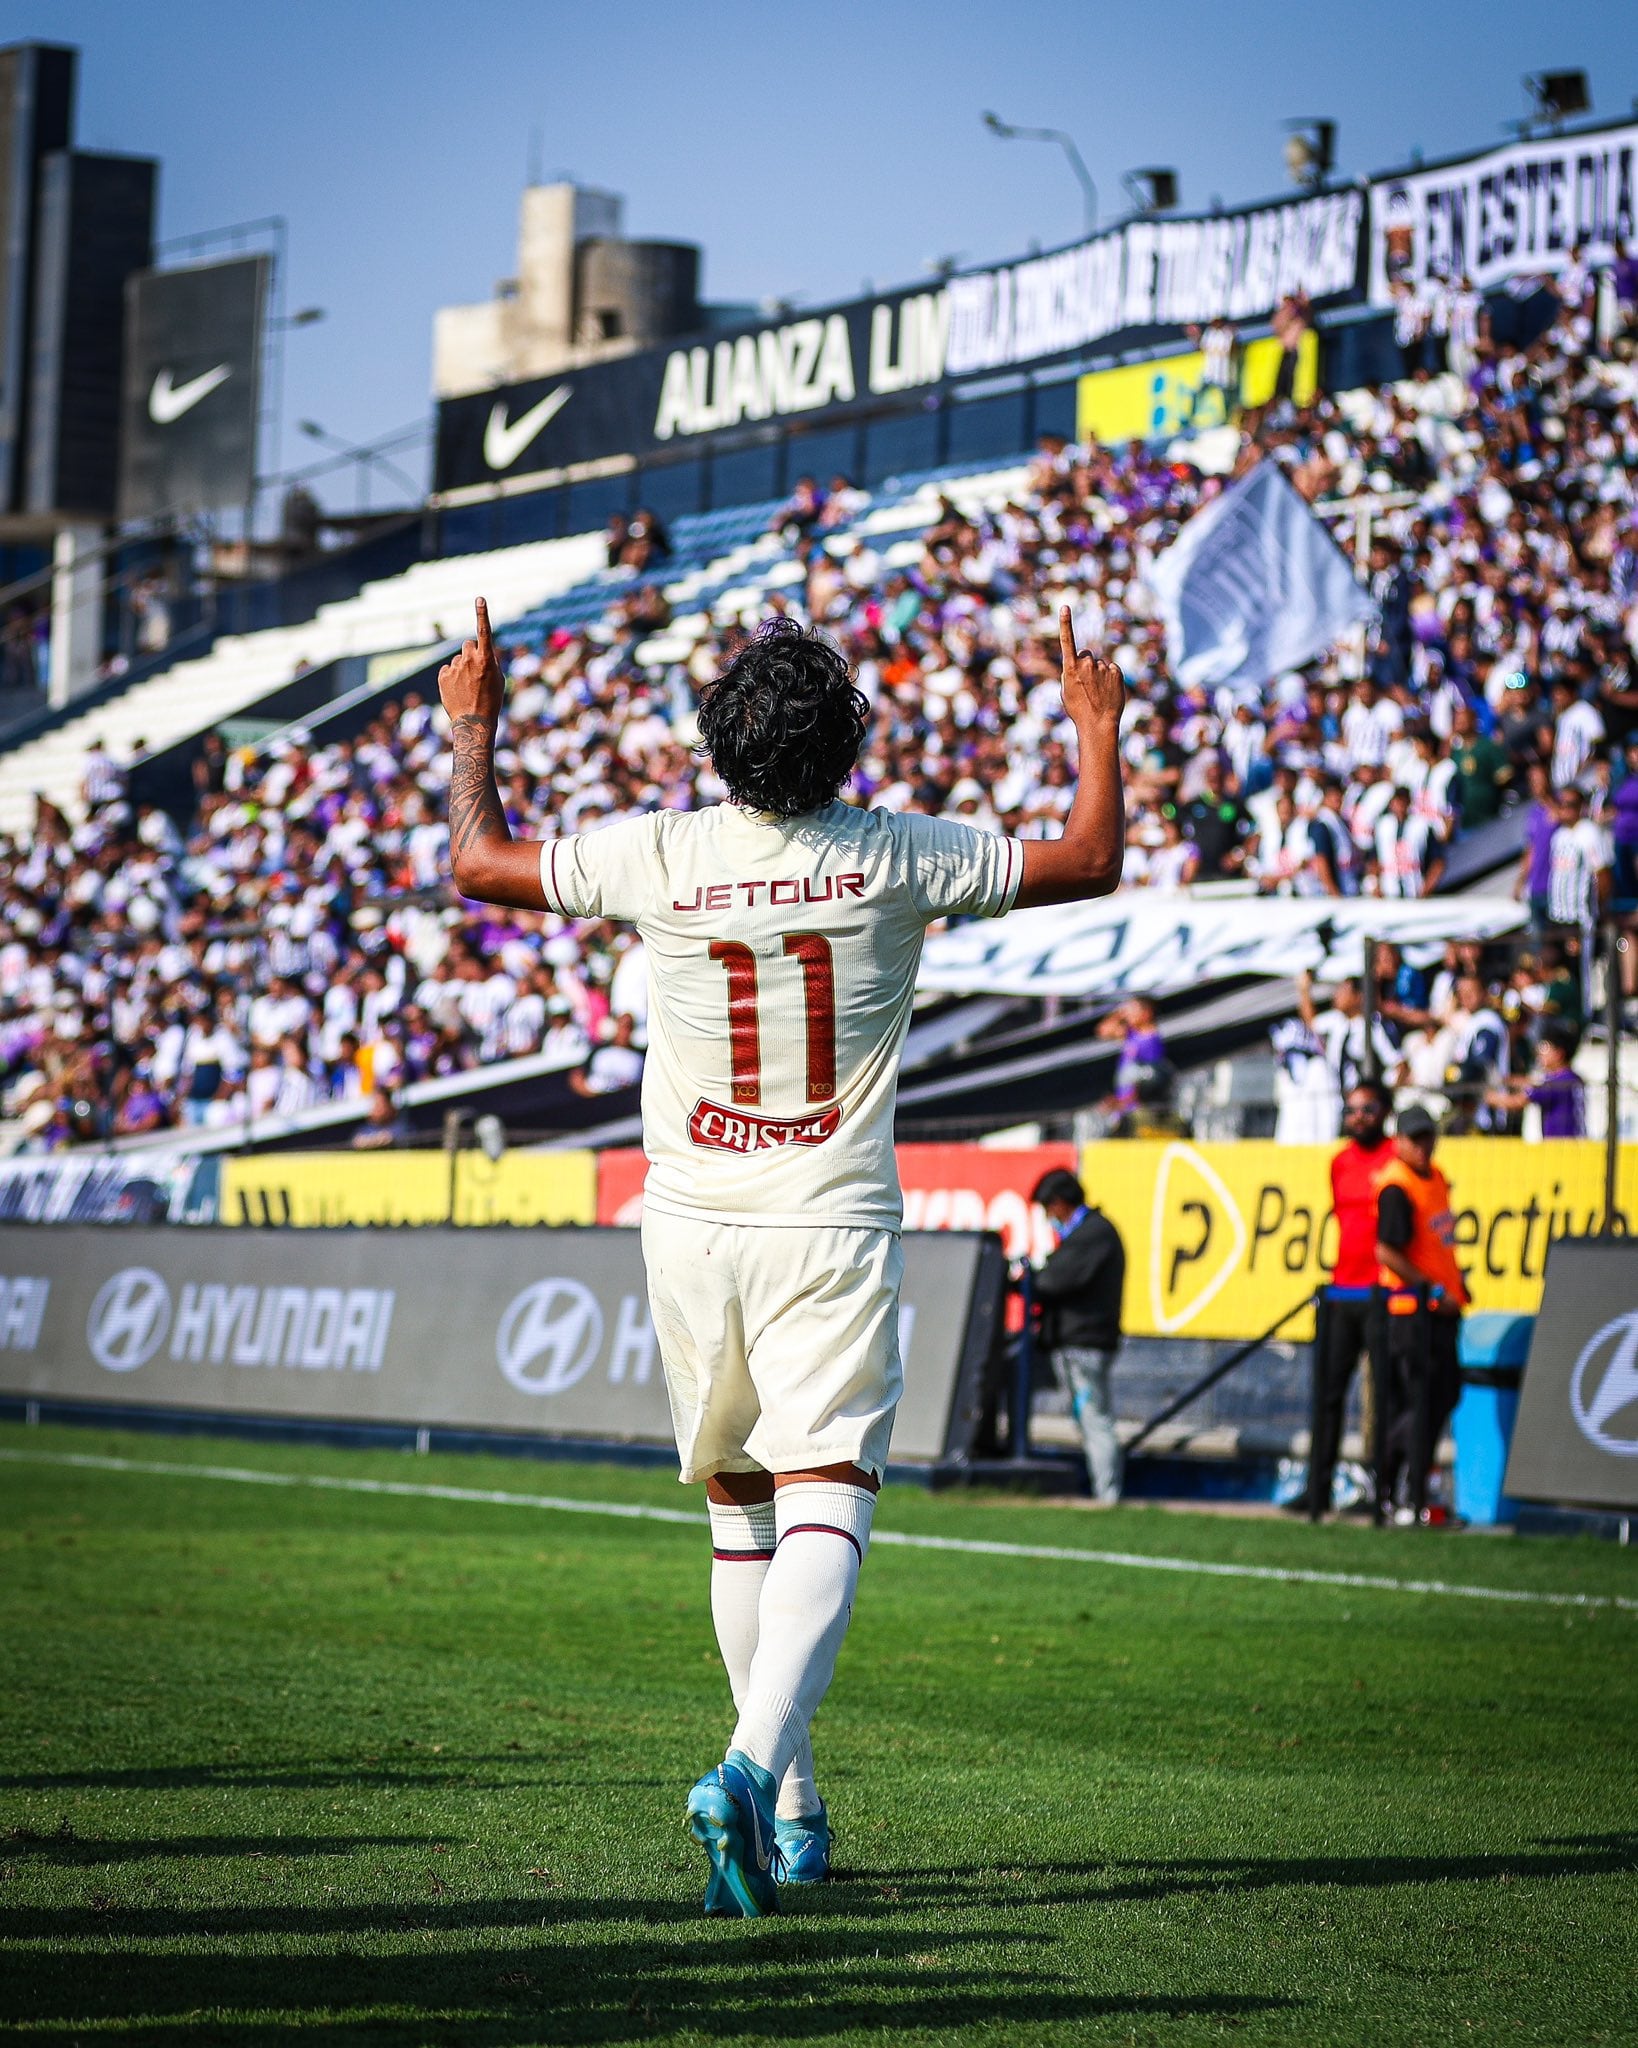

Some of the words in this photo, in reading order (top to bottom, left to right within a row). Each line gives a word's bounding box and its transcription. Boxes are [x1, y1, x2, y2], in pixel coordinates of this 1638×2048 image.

[654, 314, 855, 441] ALIANZA
[869, 290, 949, 394] LIM
[673, 873, 865, 911] JETOUR
[707, 932, 836, 1106] 11
[169, 1281, 397, 1374] HYUNDAI
